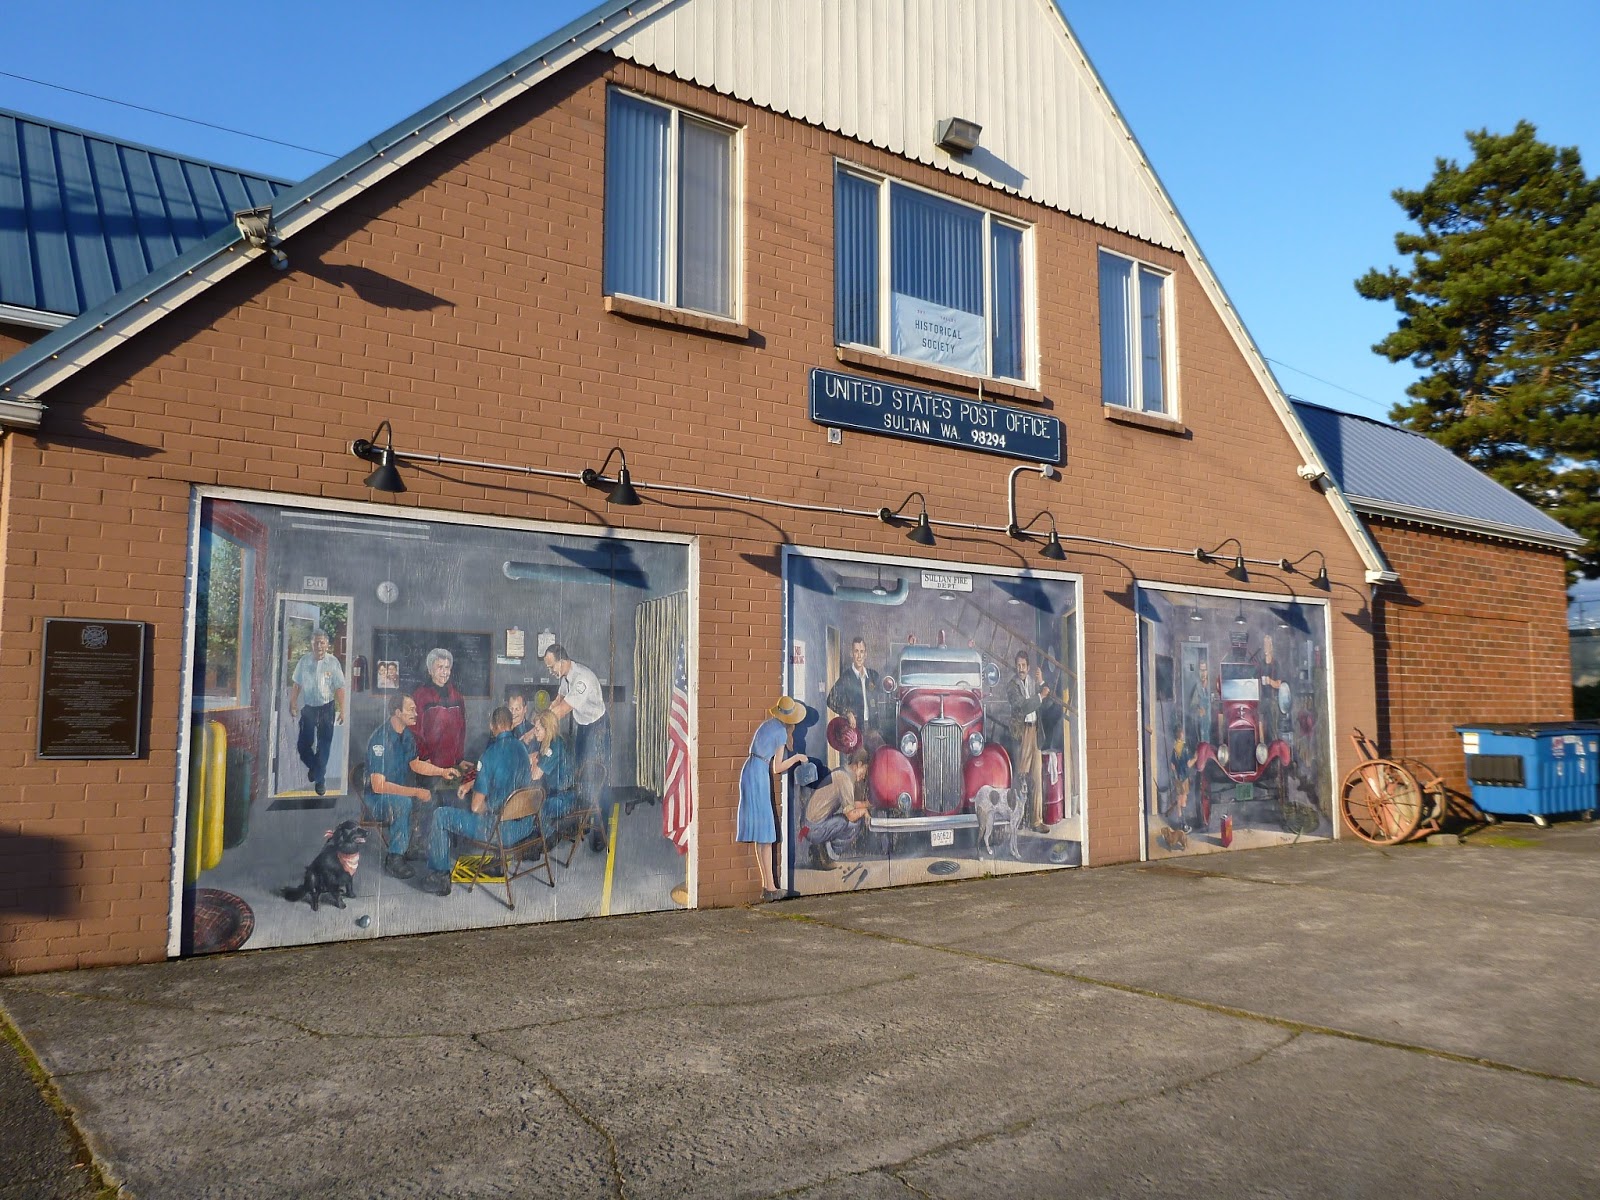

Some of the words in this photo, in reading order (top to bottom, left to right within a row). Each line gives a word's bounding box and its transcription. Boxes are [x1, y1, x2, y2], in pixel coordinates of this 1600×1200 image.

[915, 319, 962, 340] HISTORICAL
[922, 337, 955, 354] SOCIETY
[825, 375, 883, 407] UNITED
[892, 389, 952, 420] STATES
[960, 403, 998, 428] POST
[1006, 413, 1051, 439] OFFICE
[884, 413, 930, 435] SULTAN
[971, 429, 1006, 448] 98294
[306, 578, 325, 588] EXIT
[925, 574, 952, 583] SULTAN
[953, 576, 968, 585] FIRE
